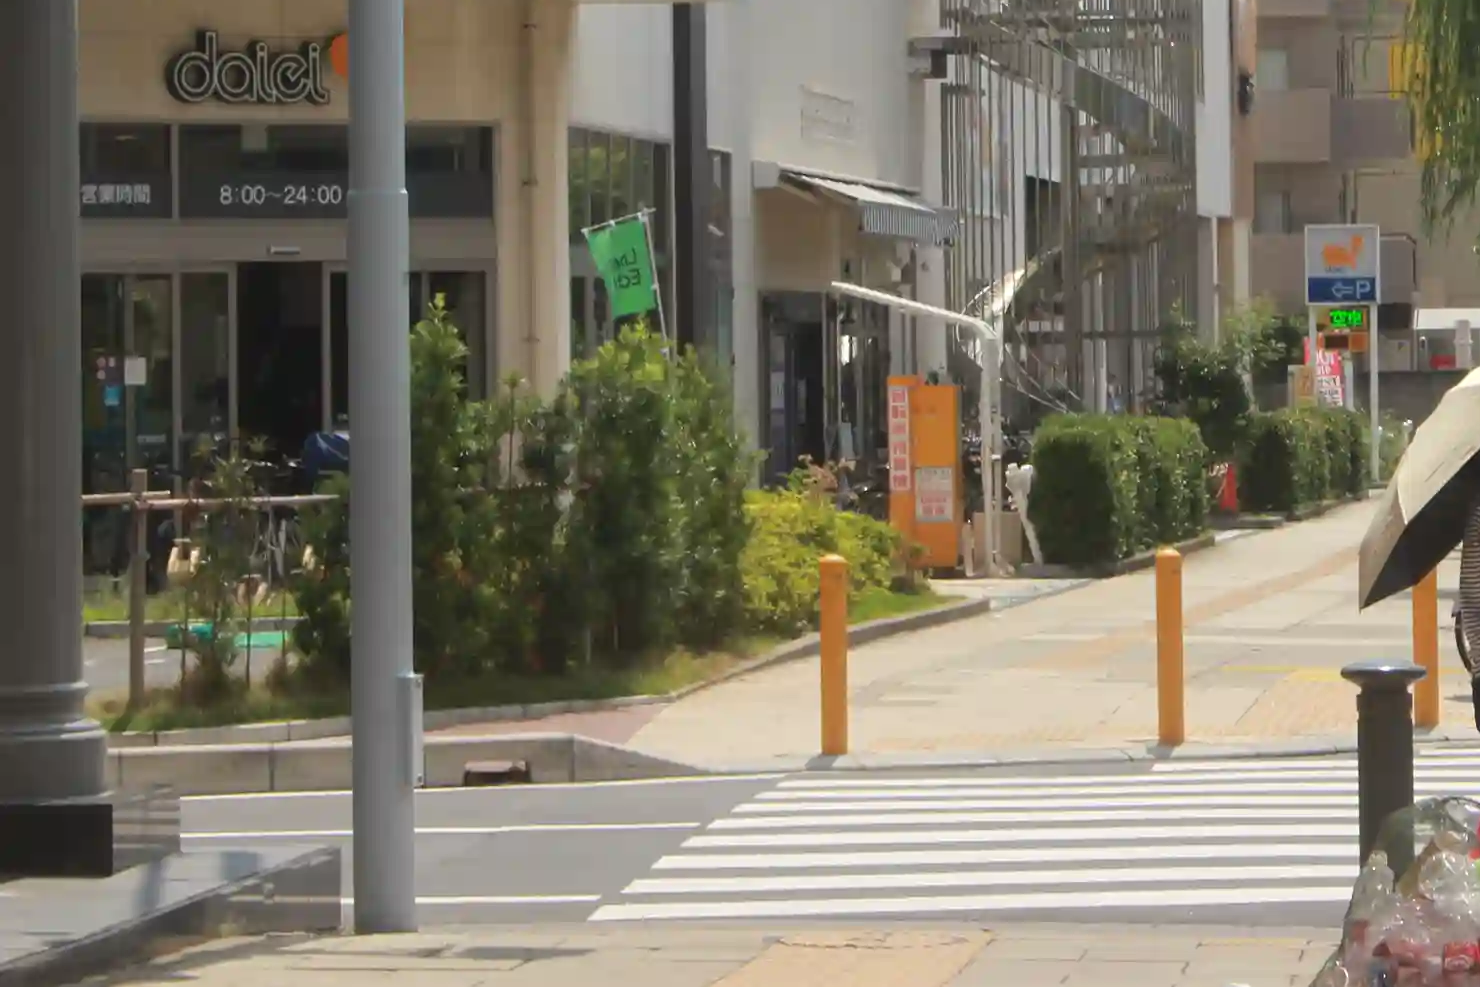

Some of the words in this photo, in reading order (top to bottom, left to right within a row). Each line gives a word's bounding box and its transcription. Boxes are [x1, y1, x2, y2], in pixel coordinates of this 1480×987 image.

[168, 30, 330, 104] daiei
[80, 183, 152, 205] 営業時間
[1355, 280, 1371, 300] P
